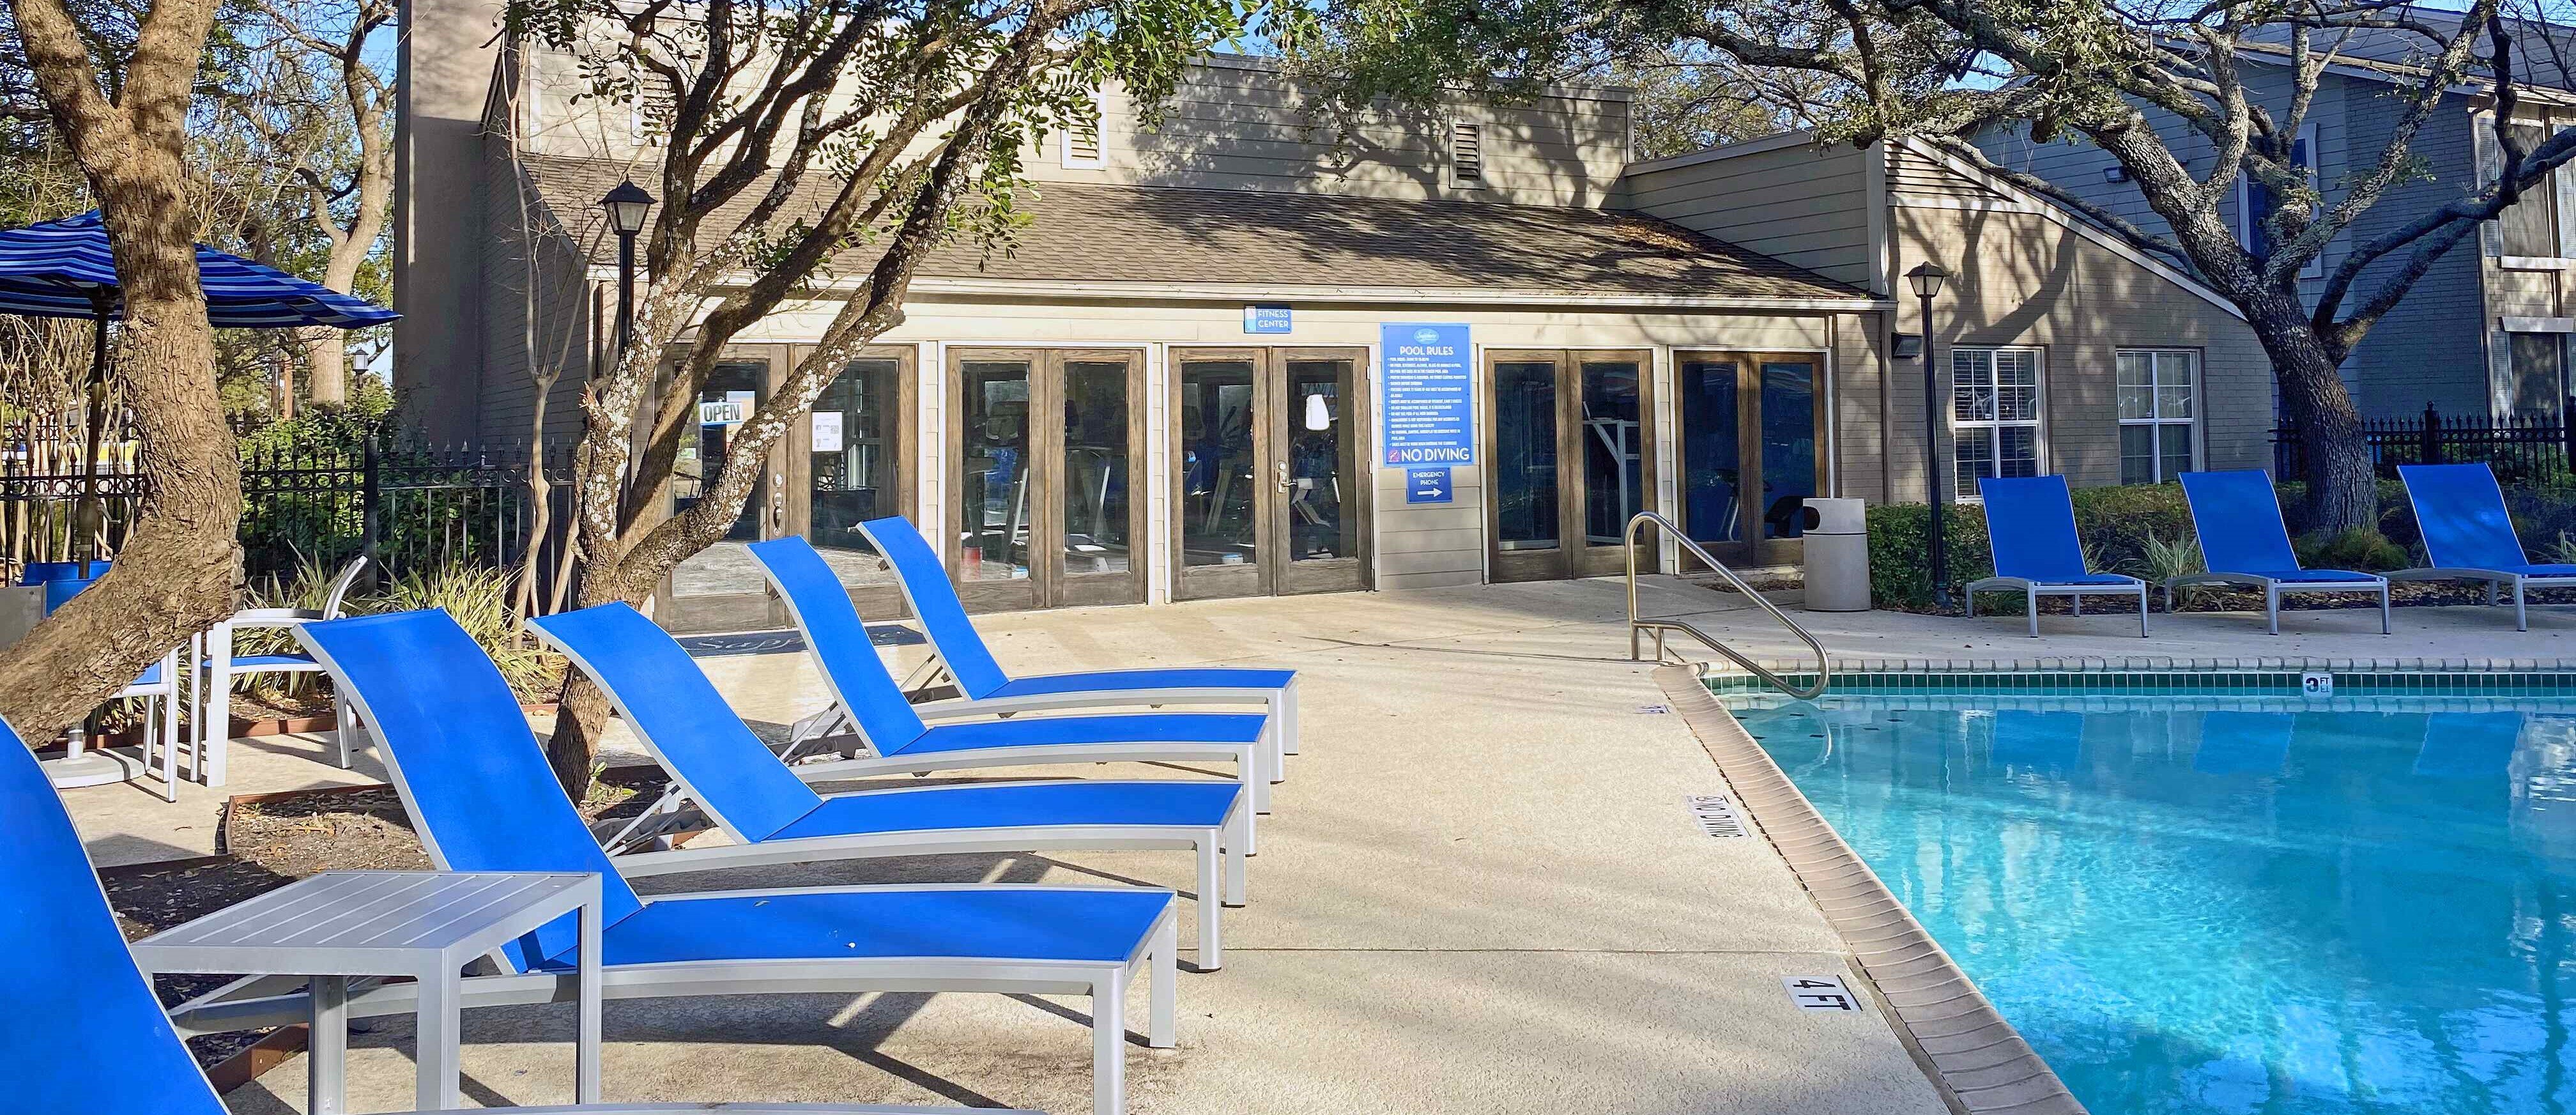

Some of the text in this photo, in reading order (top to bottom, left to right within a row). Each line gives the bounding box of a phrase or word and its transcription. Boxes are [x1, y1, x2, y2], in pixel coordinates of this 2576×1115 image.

[1257, 310, 1289, 318] FITNESS
[1257, 319, 1289, 328] CENTER
[1400, 346, 1454, 355] POOL RULES
[703, 404, 740, 422] OPEN
[1401, 447, 1469, 462] NO DIVING
[2306, 677, 2319, 692] 3
[1694, 803, 1744, 838] NO DIVING
[1793, 980, 1851, 1010] 4 FT
